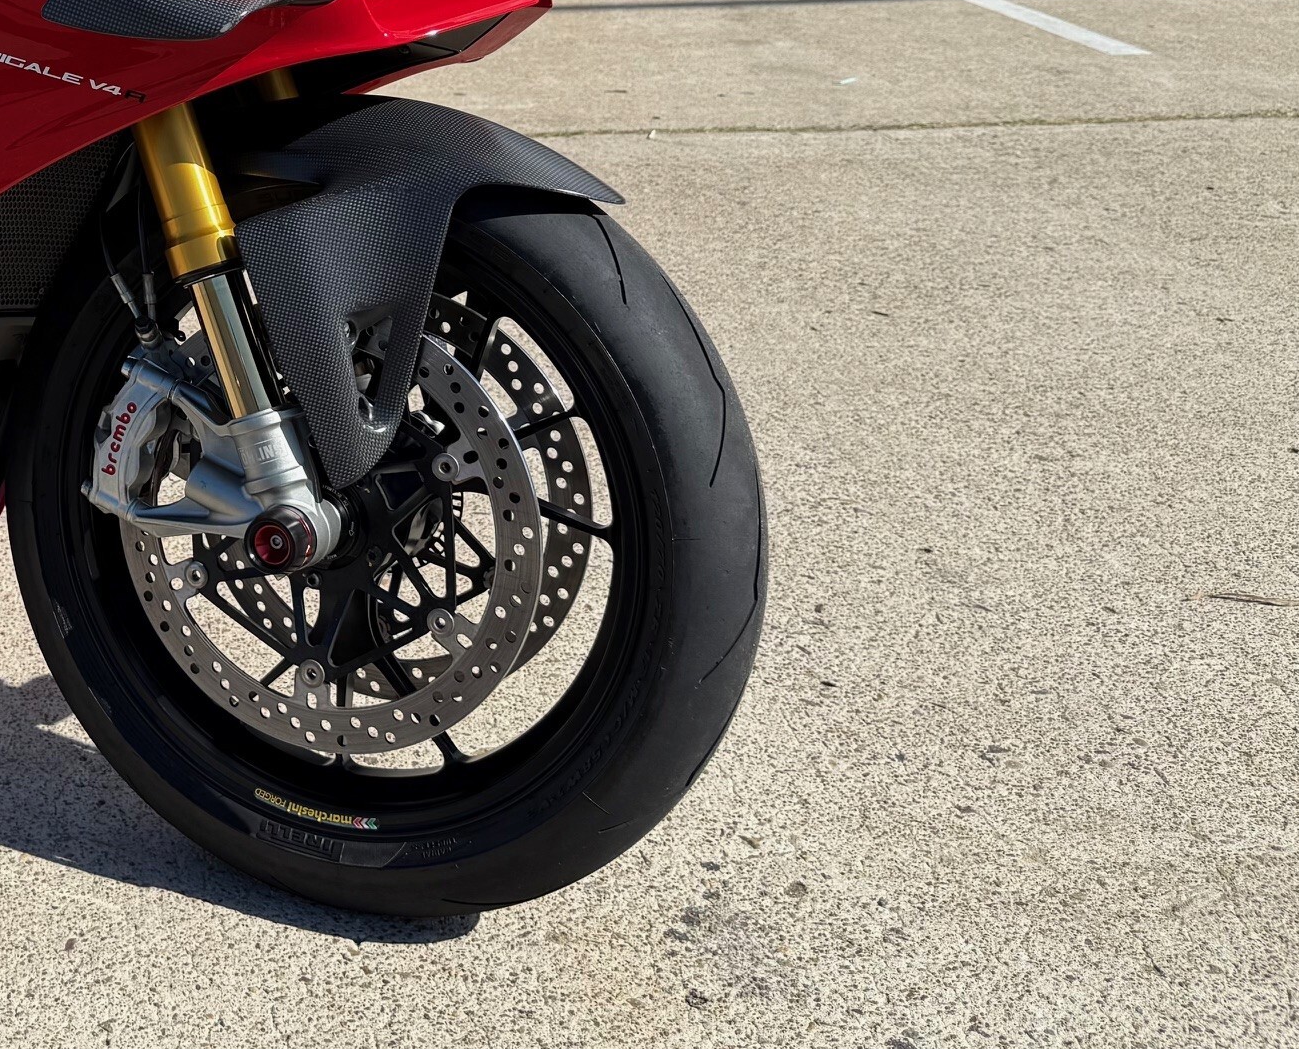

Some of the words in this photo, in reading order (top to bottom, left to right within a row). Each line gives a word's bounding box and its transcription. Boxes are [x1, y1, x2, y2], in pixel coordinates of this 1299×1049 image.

[101, 401, 138, 476] brembo
[254, 787, 286, 808] FORGED
[287, 801, 352, 825] marchesini
